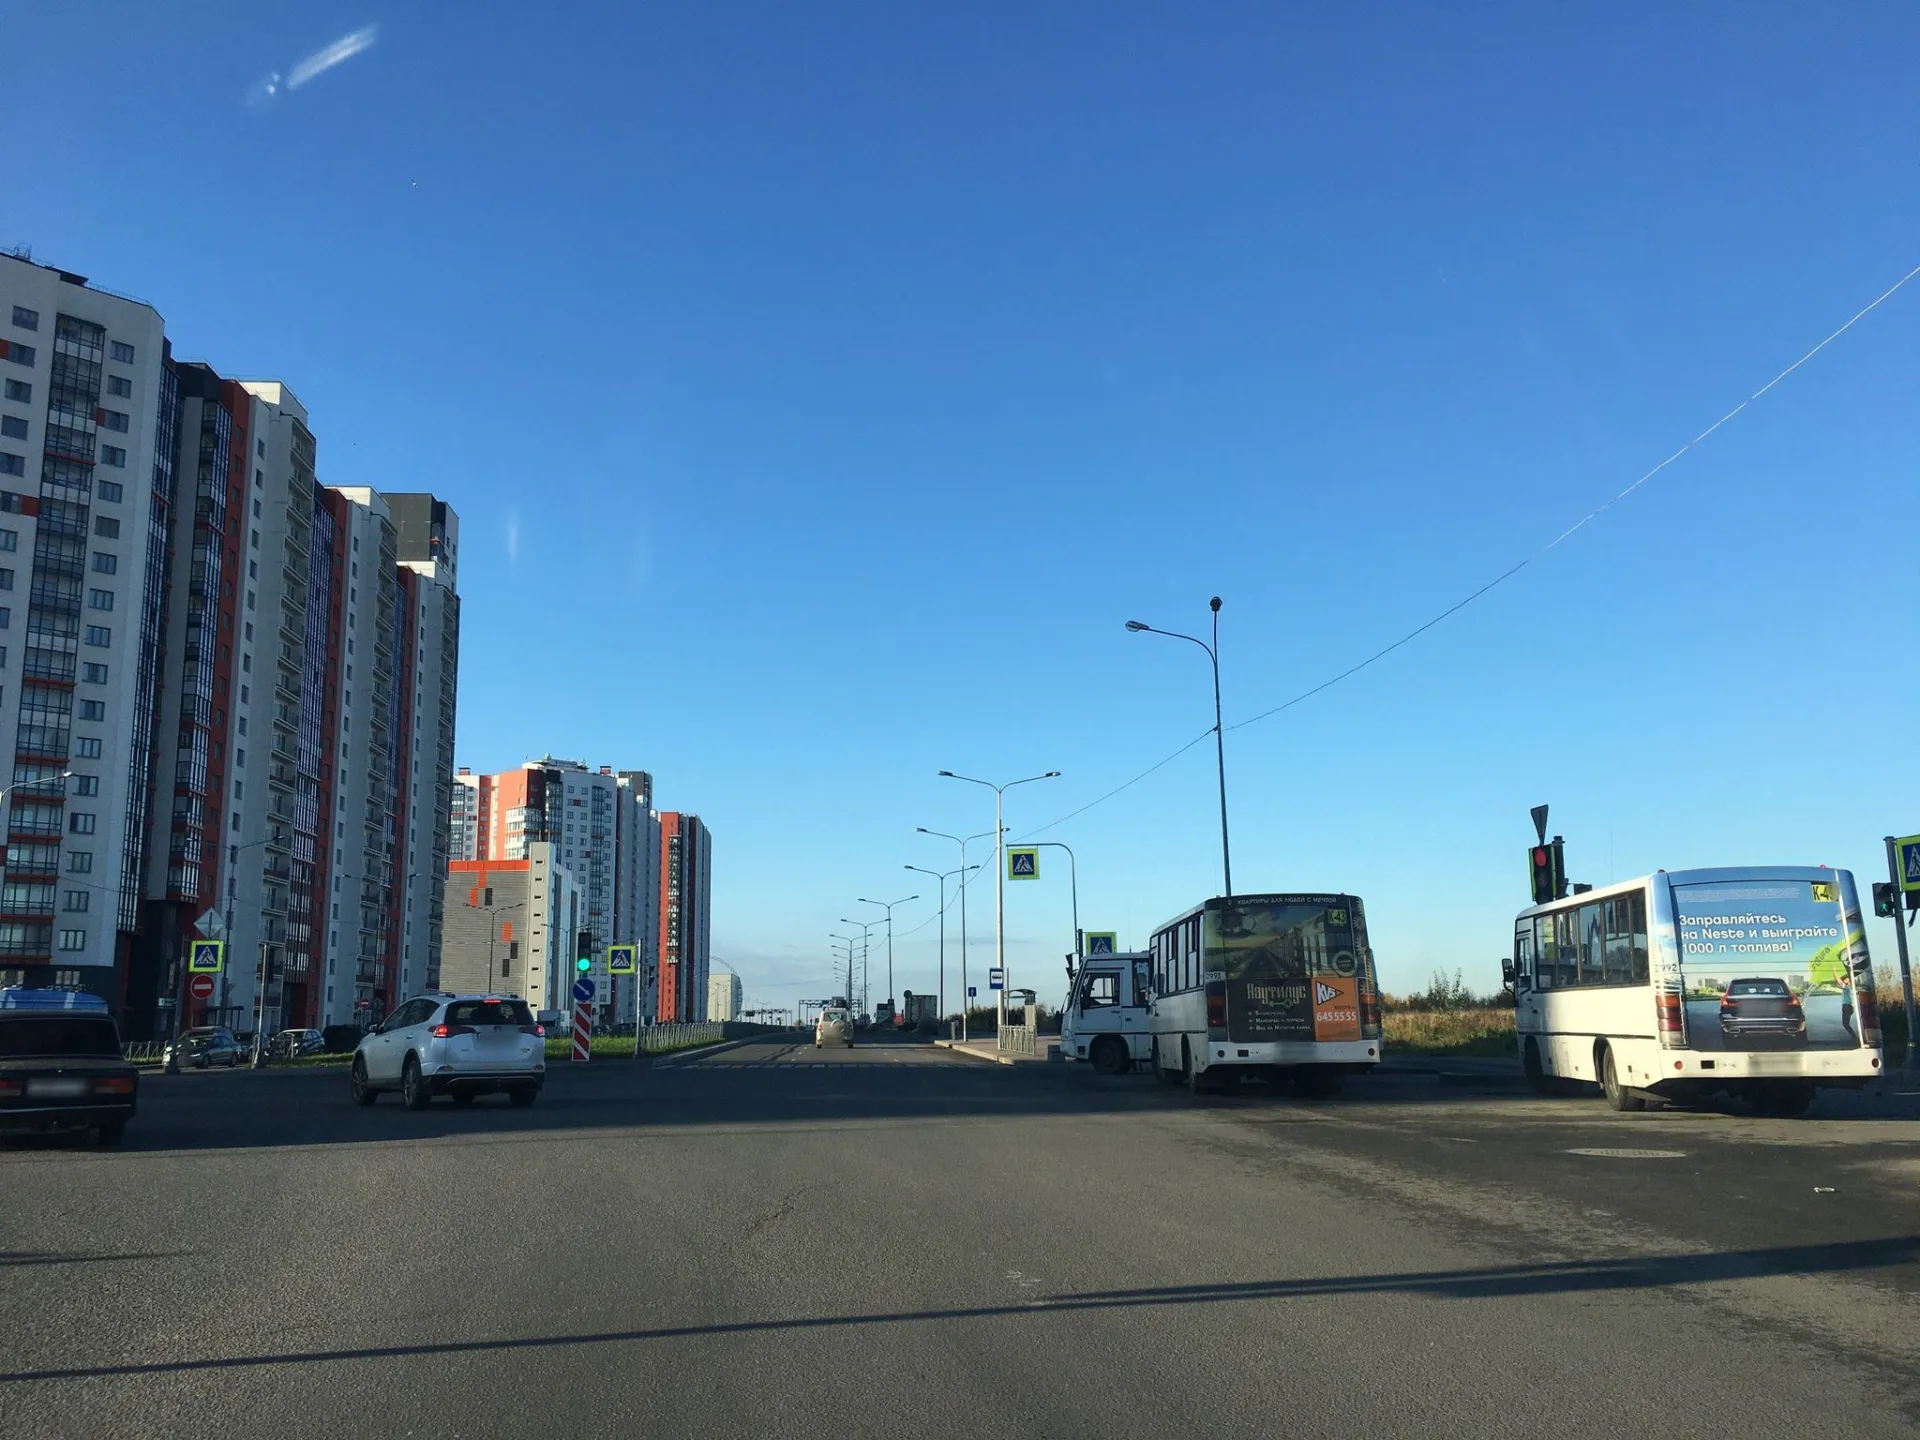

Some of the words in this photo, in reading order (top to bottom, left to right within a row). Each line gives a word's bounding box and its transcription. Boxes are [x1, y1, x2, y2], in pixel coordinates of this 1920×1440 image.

[1679, 913, 1786, 927] Заправляйтесь
[1681, 930, 1698, 940] на
[1702, 928, 1744, 939] Neste
[1749, 928, 1758, 938] и
[1762, 925, 1838, 940] выиграйте
[1682, 943, 1714, 954] 1000
[1718, 944, 1727, 953] л
[1731, 943, 1793, 953] топлива!
